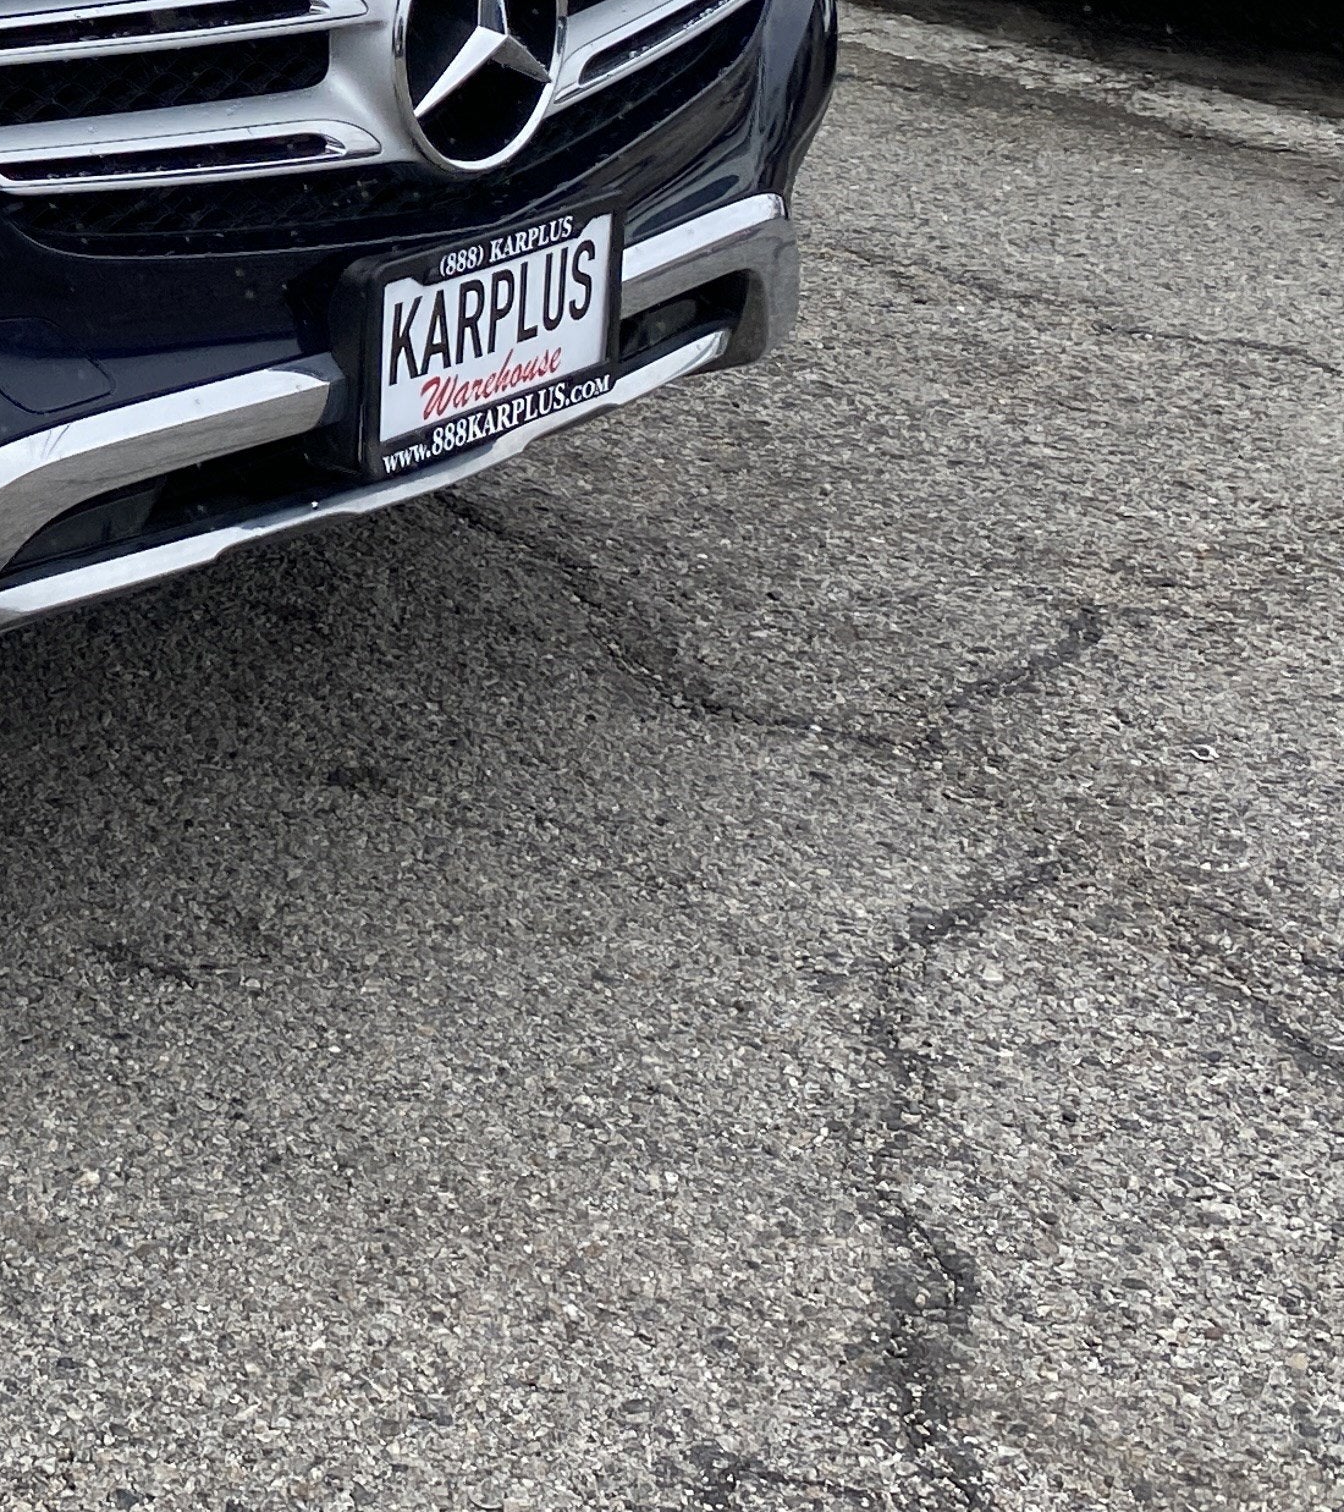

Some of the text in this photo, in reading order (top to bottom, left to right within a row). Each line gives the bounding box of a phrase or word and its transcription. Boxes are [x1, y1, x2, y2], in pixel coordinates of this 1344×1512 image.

[438, 215, 574, 277] (888) KARPLUS
[388, 238, 596, 386] KARPLUS
[419, 346, 563, 421] Warehouse
